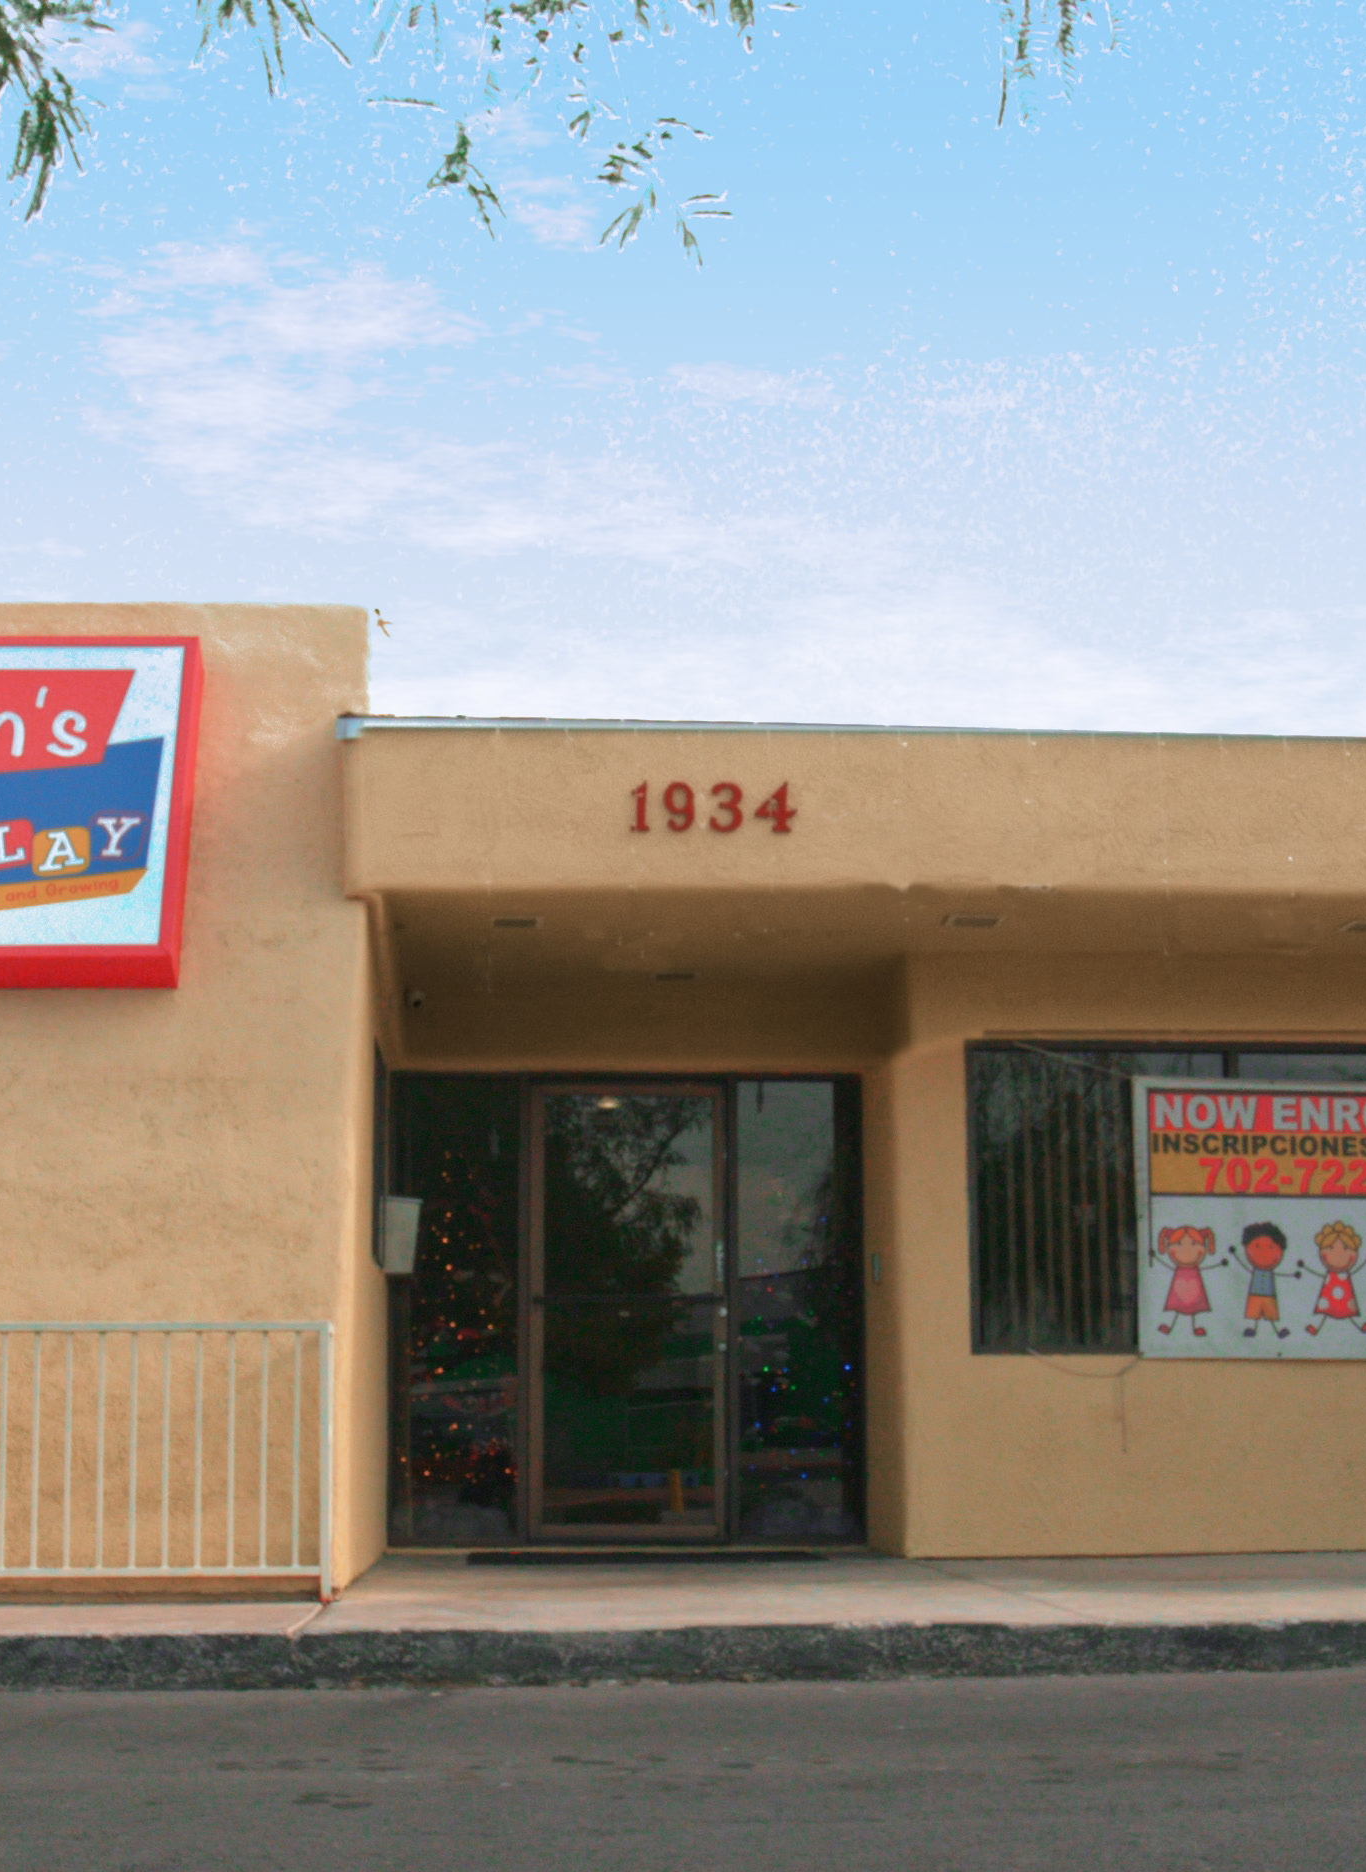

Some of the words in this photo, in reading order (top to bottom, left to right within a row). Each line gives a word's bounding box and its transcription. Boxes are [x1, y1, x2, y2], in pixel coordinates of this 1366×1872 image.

[629, 780, 798, 834] 1934
[5, 886, 37, 903] and
[45, 879, 120, 899] Growing
[1153, 1094, 1258, 1130] NOW
